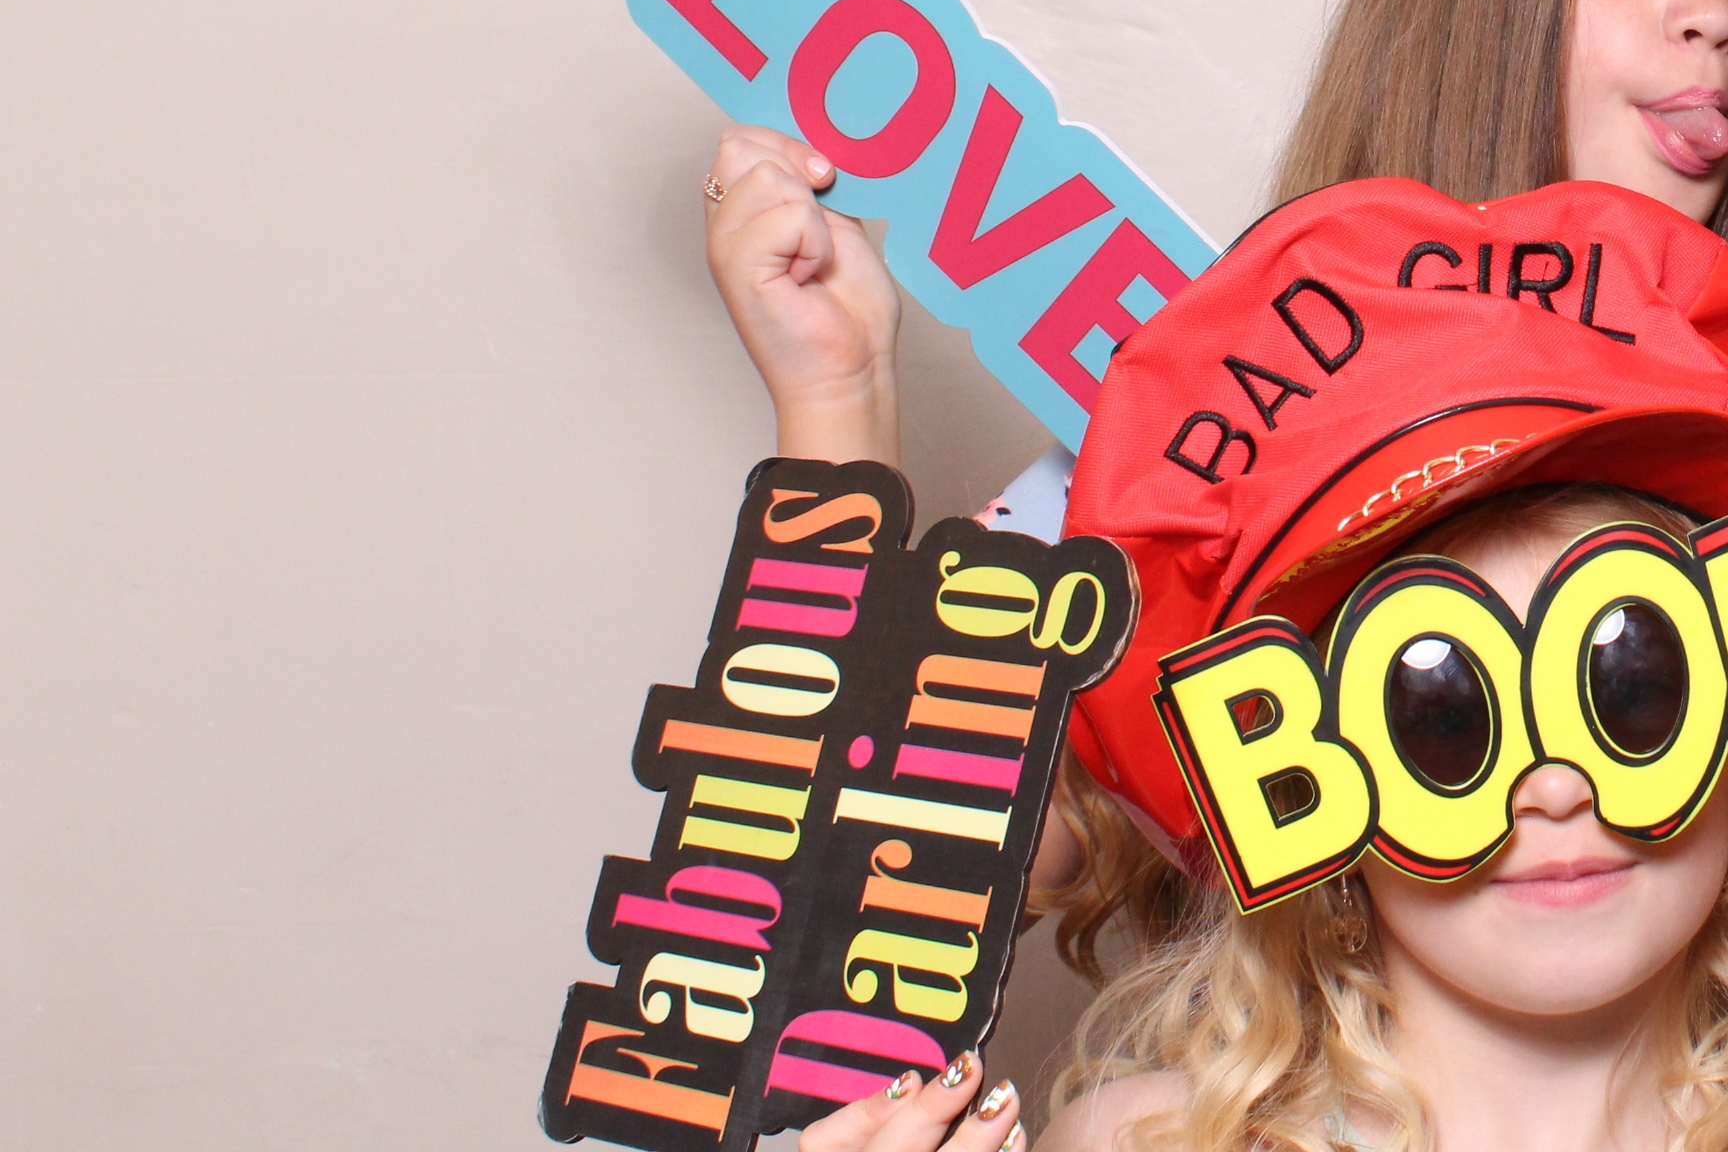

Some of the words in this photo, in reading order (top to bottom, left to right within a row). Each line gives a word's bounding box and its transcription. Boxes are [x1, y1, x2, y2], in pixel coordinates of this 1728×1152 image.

[1163, 277, 1364, 485] BAD
[565, 488, 883, 1143] Fabulous
[764, 550, 1106, 1102] Darling
